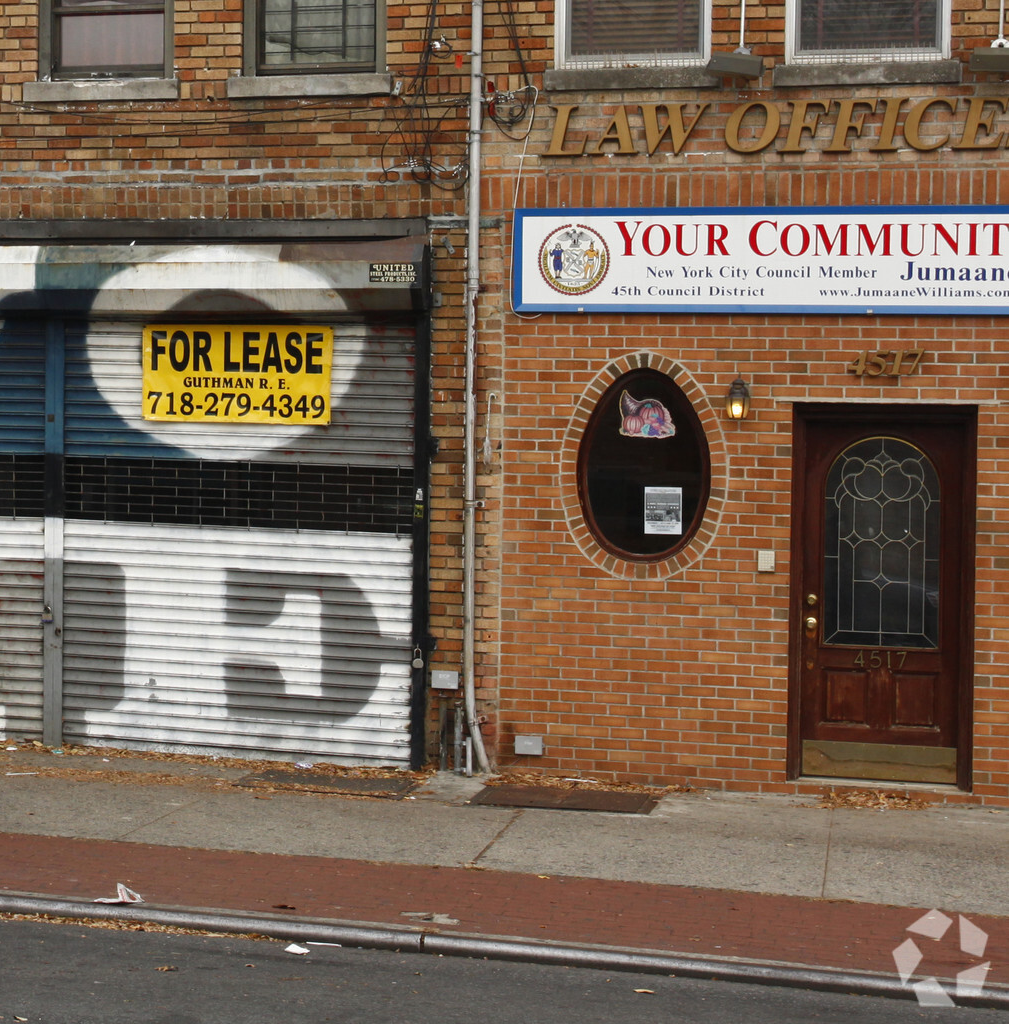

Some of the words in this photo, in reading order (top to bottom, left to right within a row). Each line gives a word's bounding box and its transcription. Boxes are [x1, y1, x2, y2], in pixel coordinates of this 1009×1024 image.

[542, 103, 710, 156] LAW
[722, 96, 1009, 153] OFFICE
[614, 220, 730, 257] YOUR
[646, 267, 674, 278] New
[682, 266, 713, 278] York
[720, 266, 749, 281] City
[756, 266, 811, 278] Council
[818, 266, 877, 278] Member
[899, 261, 1009, 281] Jumaan
[611, 286, 641, 297] 45th
[647, 285, 701, 297] Council
[709, 285, 765, 298] District
[150, 330, 212, 372] FOR
[223, 331, 324, 375] LEASE
[847, 348, 925, 376] 4517
[183, 377, 254, 389] GUTHMAN
[259, 379, 273, 390] R.
[279, 380, 290, 391] E.
[147, 391, 326, 420] 718-279-4349
[853, 650, 907, 669] 4517
